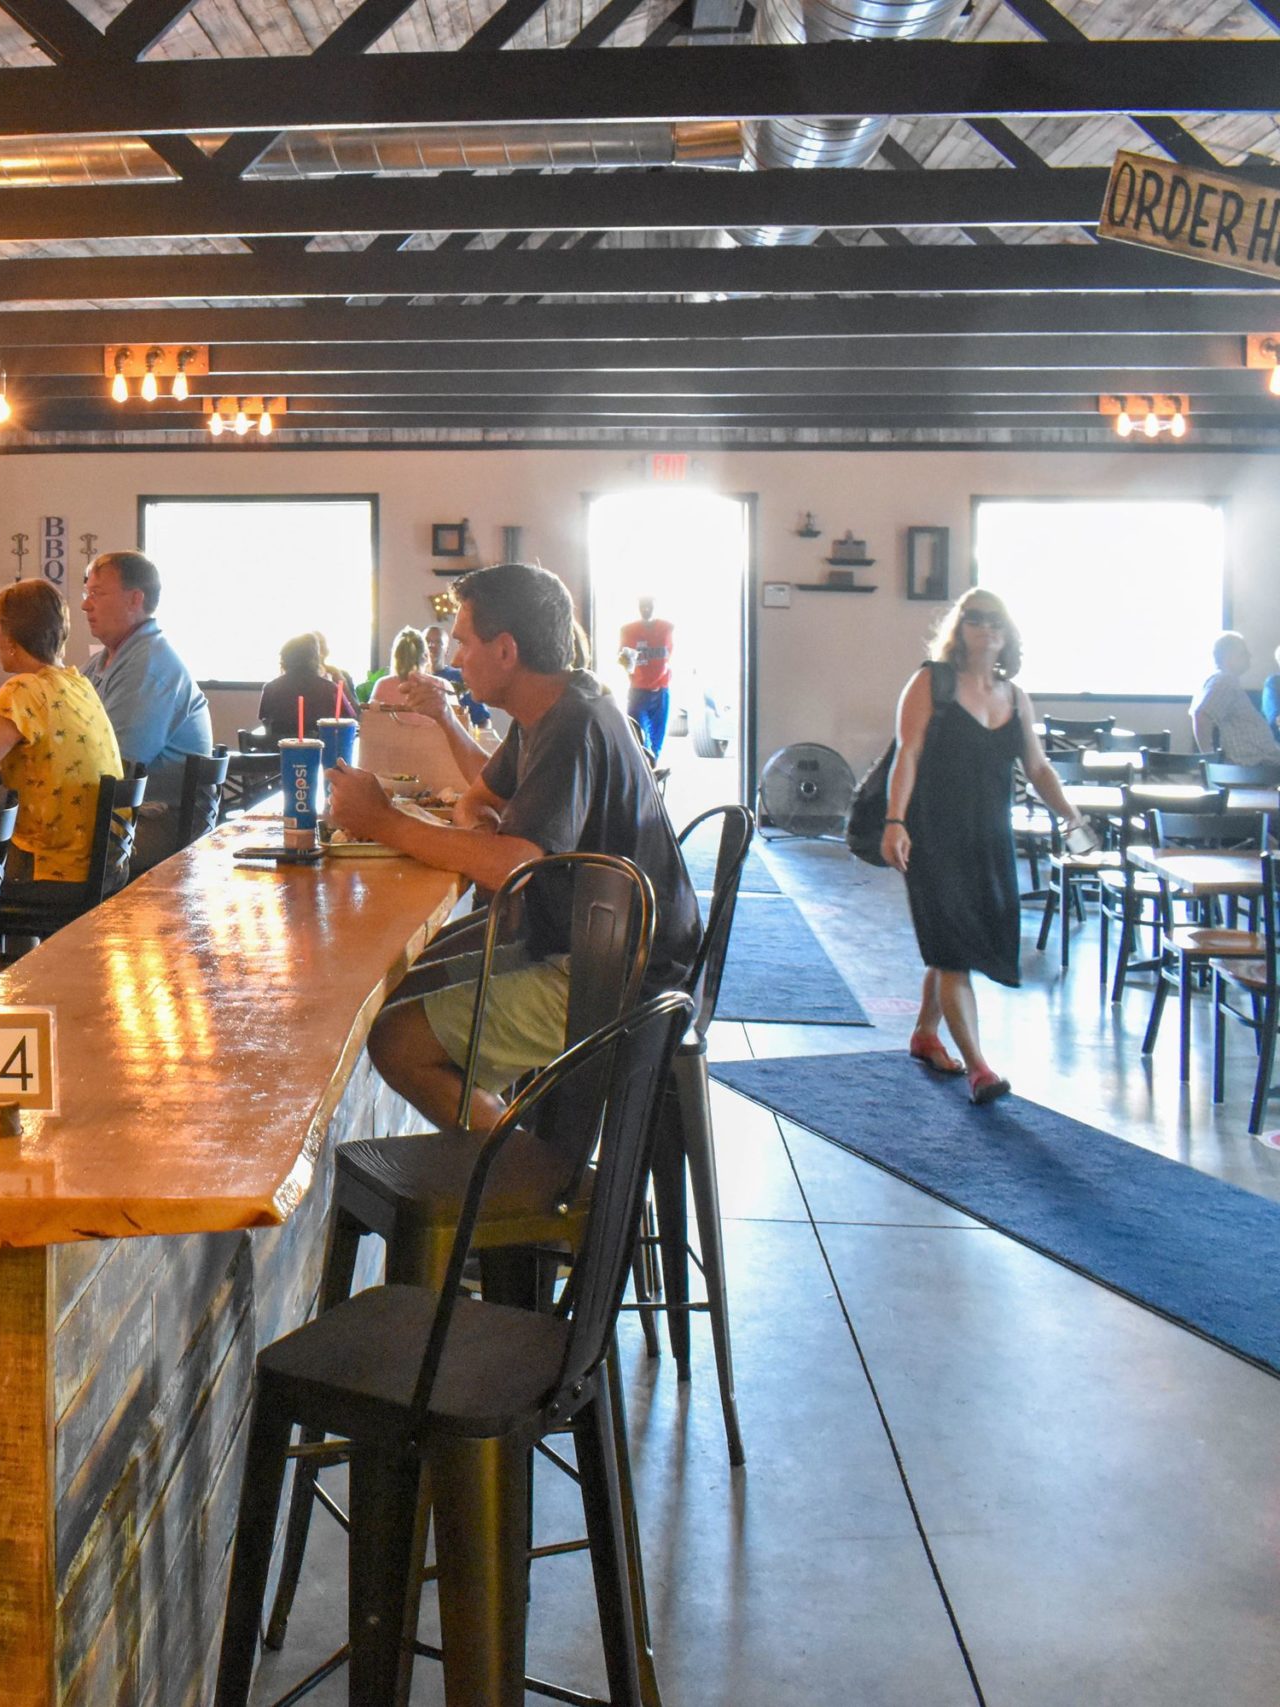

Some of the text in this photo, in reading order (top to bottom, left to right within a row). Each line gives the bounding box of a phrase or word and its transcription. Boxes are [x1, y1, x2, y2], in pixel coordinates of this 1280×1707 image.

[1108, 161, 1280, 267] ORDER H
[653, 455, 686, 480] EXIT
[44, 516, 64, 585] BBQ
[292, 763, 310, 813] pepsi
